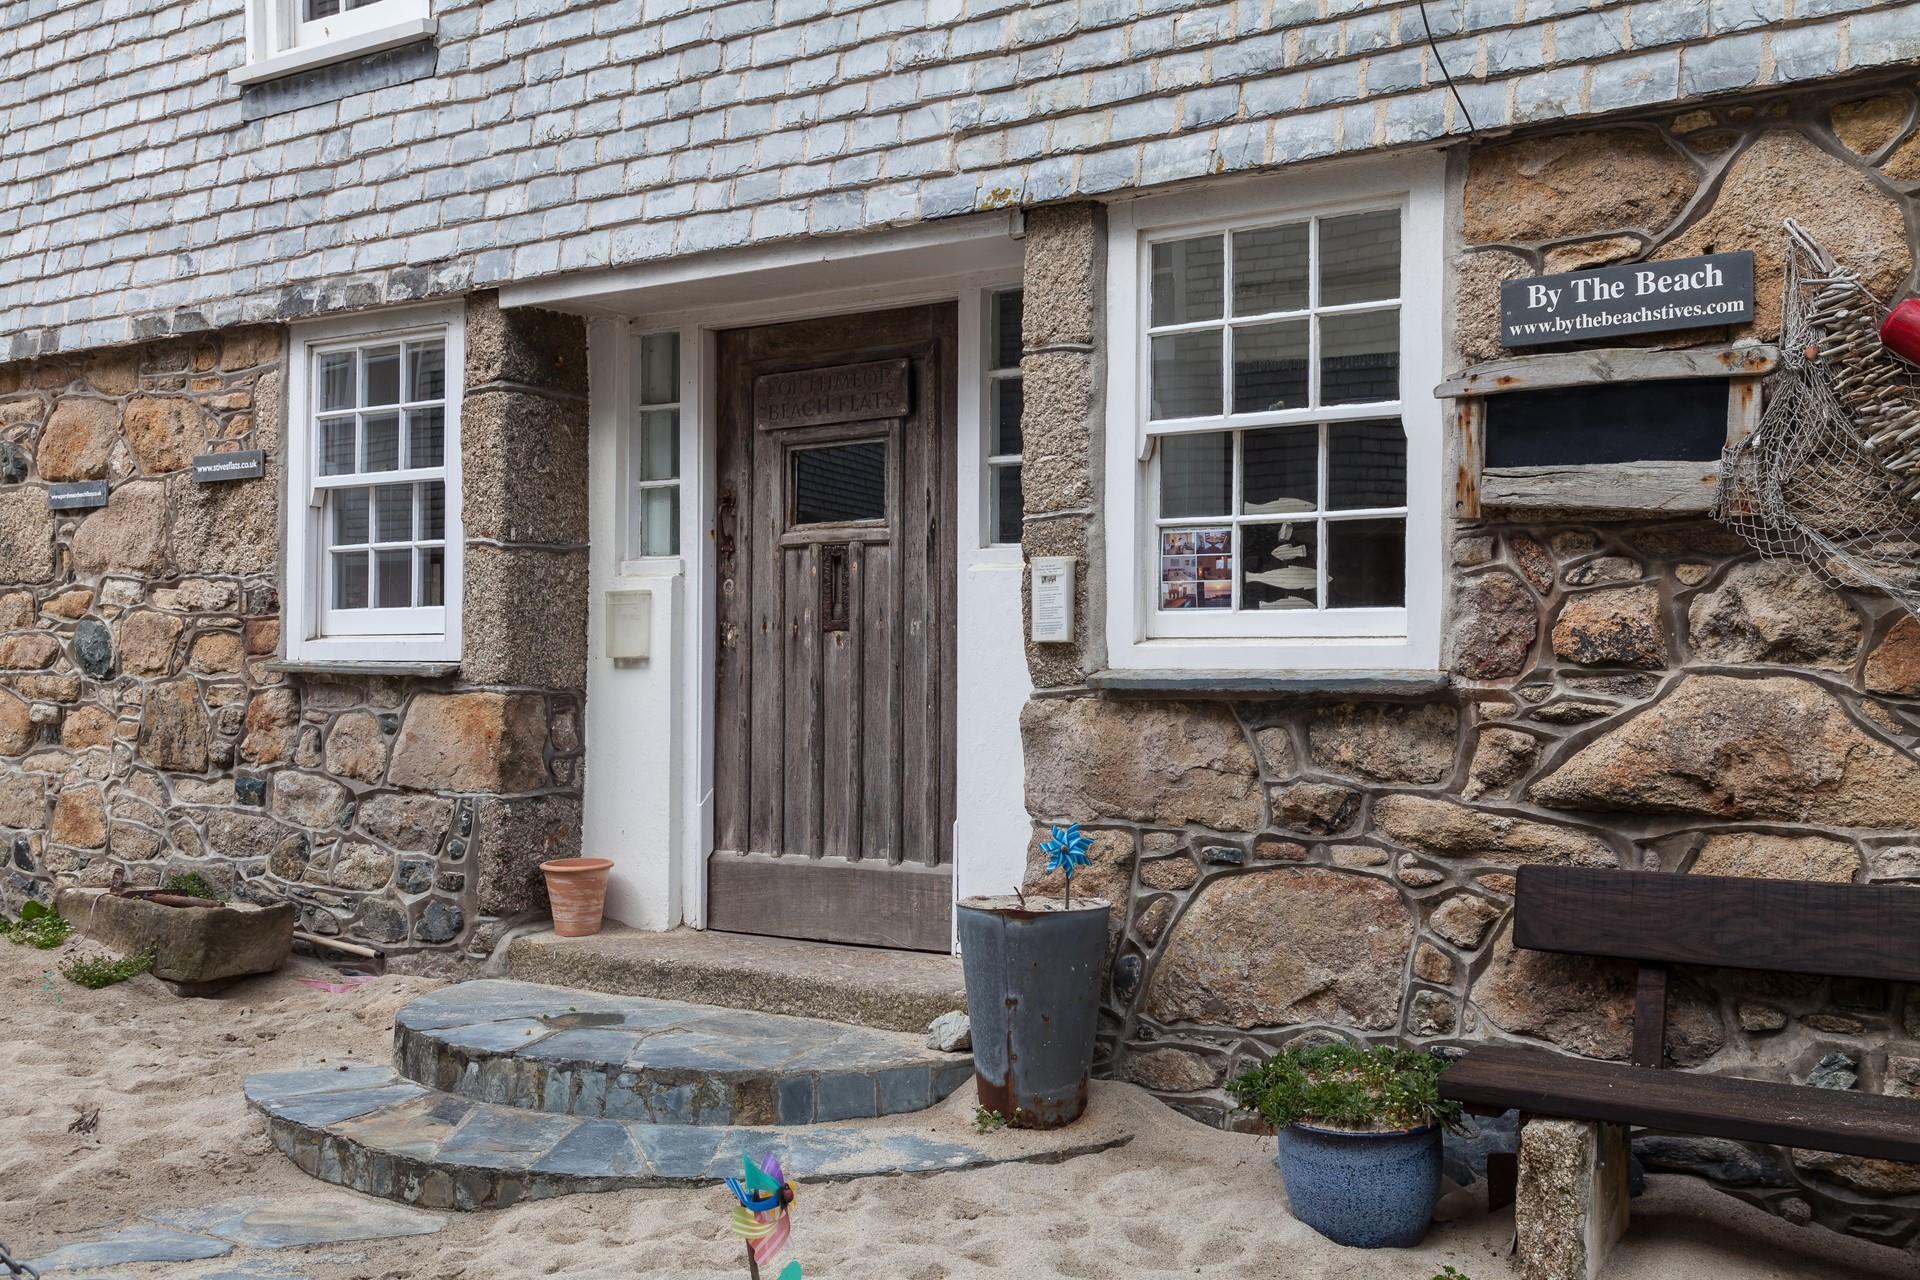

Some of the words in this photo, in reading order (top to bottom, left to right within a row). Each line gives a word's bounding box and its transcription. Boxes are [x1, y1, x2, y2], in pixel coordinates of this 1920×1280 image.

[1527, 284, 1562, 312] By
[1571, 277, 1625, 303] The
[1635, 263, 1724, 297] Beach
[1509, 300, 1745, 336] www.bythebeachstives.com
[768, 398, 830, 421] BEACH
[838, 391, 895, 412] FLATS
